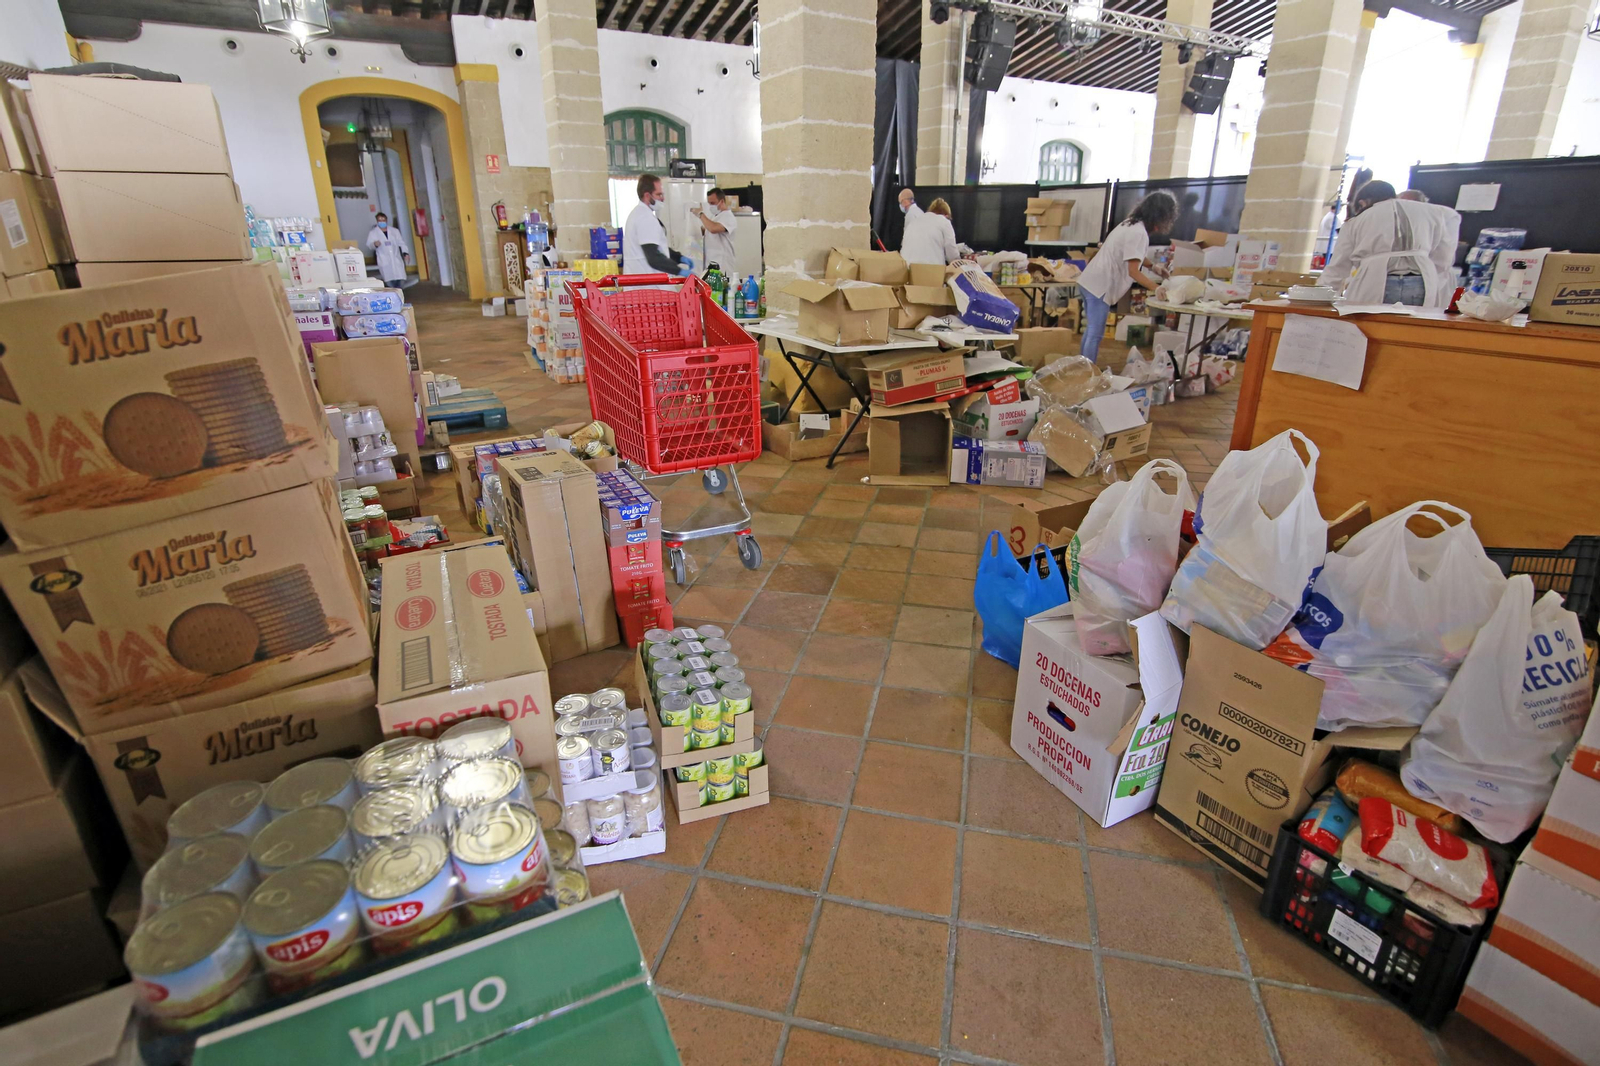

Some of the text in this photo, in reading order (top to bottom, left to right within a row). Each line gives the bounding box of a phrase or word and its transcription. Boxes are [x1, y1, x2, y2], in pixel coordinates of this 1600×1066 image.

[984, 313, 1011, 326] CANDEAL
[58, 308, 202, 365] María
[1005, 410, 1026, 419] DOCENAS
[622, 506, 649, 516] PULEVA
[628, 531, 647, 539] PULEVA
[128, 530, 257, 587] María
[405, 561, 422, 592] TOSTADA
[481, 571, 495, 597] Cuétara
[407, 598, 423, 630] Cuétara
[484, 603, 508, 641] TOSTADA
[1554, 628, 1576, 652] %
[1036, 652, 1101, 708] 20 DOCENAS
[1040, 673, 1090, 717] ESTUCHADOS
[1234, 672, 1262, 690] 2593426
[203, 714, 319, 766] María
[1027, 711, 1091, 770] PRODUCCION
[1181, 713, 1240, 752] CONEJO
[1223, 706, 1299, 751] 000002007821
[1038, 736, 1073, 775] PROPIA
[1262, 772, 1278, 783] APTA
[372, 902, 418, 927] apis
[271, 934, 324, 963] apis
[349, 976, 507, 1059] OLIVA
